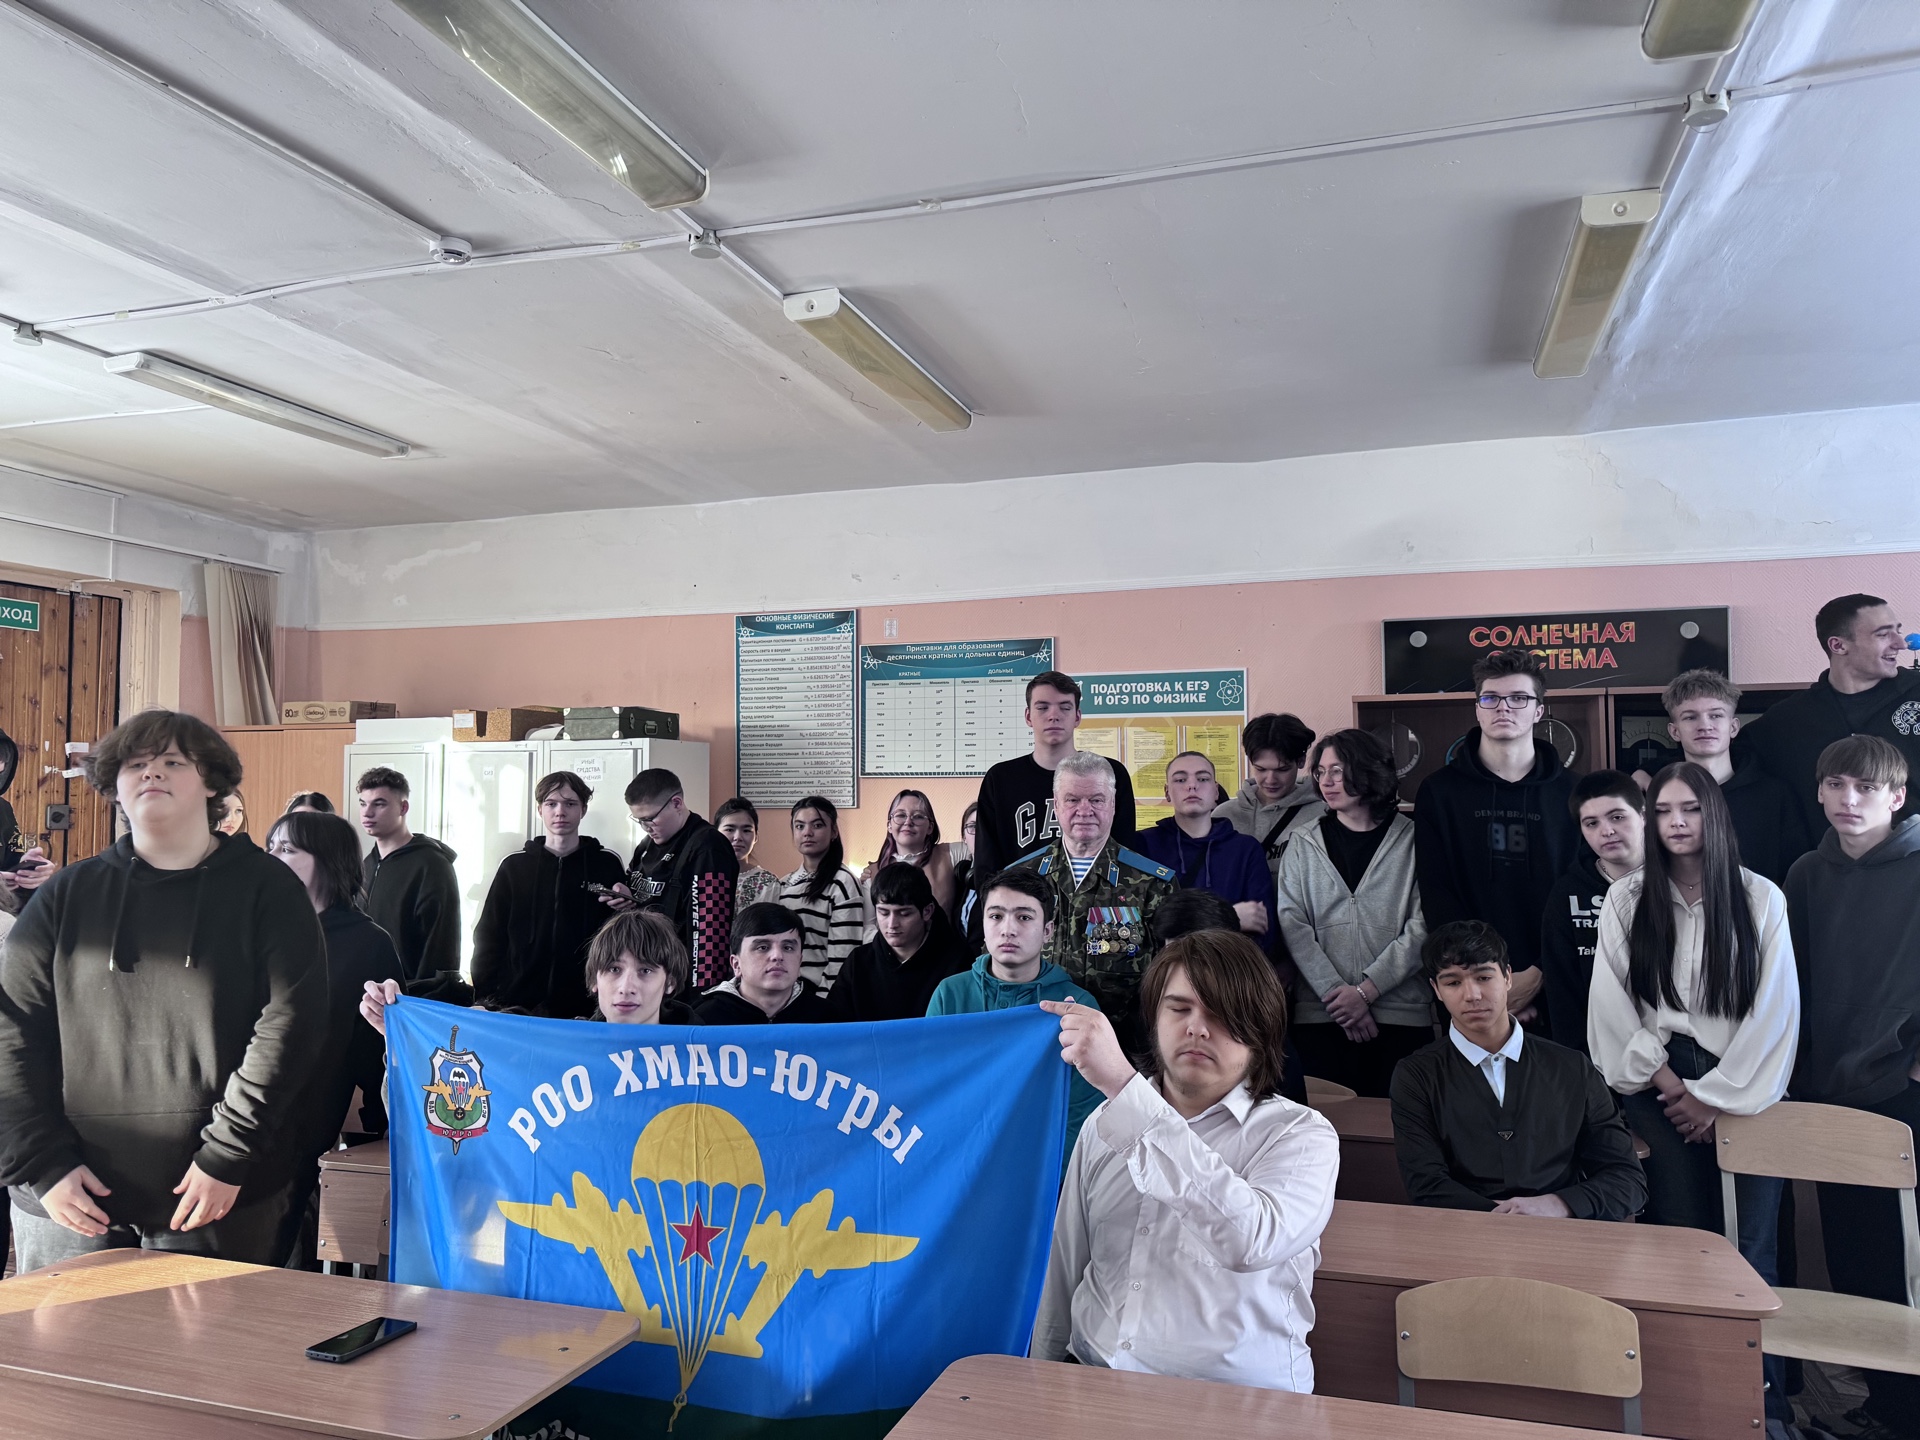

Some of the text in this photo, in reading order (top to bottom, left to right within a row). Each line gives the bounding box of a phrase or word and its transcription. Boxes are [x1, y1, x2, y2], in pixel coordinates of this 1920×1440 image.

[0, 606, 32, 624] ХОД
[756, 614, 791, 622] ОСНОВНЫЕ
[1469, 622, 1636, 647] СОЛНЕЧНАЯ
[906, 645, 942, 653] Приставки
[958, 642, 1004, 651] образования
[886, 653, 927, 662] десятичных
[928, 652, 957, 660] кратных
[965, 650, 996, 659] дольных
[998, 649, 1025, 658] единиц
[1090, 680, 1210, 694] ПОДГОТОВКА К ЕГЭ
[1094, 693, 1206, 705] И ОГЭ ПО ФИЗИКЕ
[285, 709, 293, 717] 80
[1488, 823, 1527, 852] 86
[507, 1065, 594, 1154] РОО
